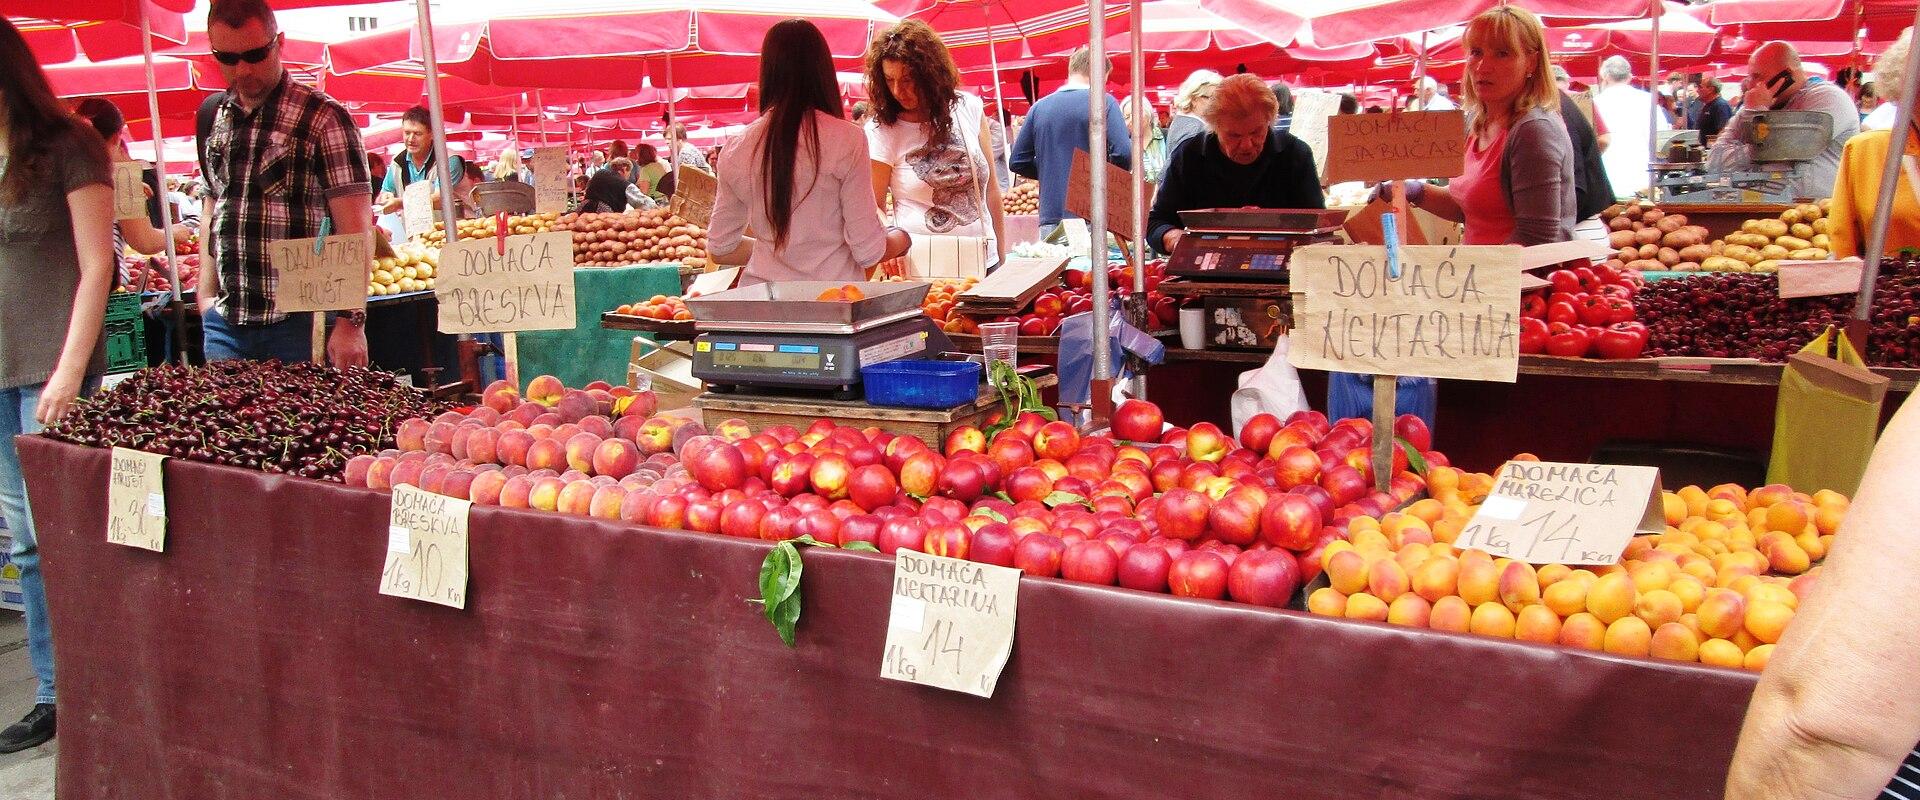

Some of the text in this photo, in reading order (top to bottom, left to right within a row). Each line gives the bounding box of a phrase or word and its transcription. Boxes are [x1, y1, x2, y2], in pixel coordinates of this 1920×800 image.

[458, 236, 554, 276] DOMAĆA
[1328, 248, 1486, 303] DOMAĆA
[452, 281, 568, 327] BRESKVA
[1322, 305, 1516, 361] NEKTARINA
[1498, 479, 1616, 507] MARELICA
[1504, 463, 1619, 486] DOMAĆA
[392, 507, 461, 537] BRESKVA
[1521, 510, 1581, 561] 14
[411, 539, 443, 597] 10
[900, 554, 989, 590] DOMAĆA
[895, 576, 1000, 617] NEKTARINA
[923, 619, 964, 675] 14
